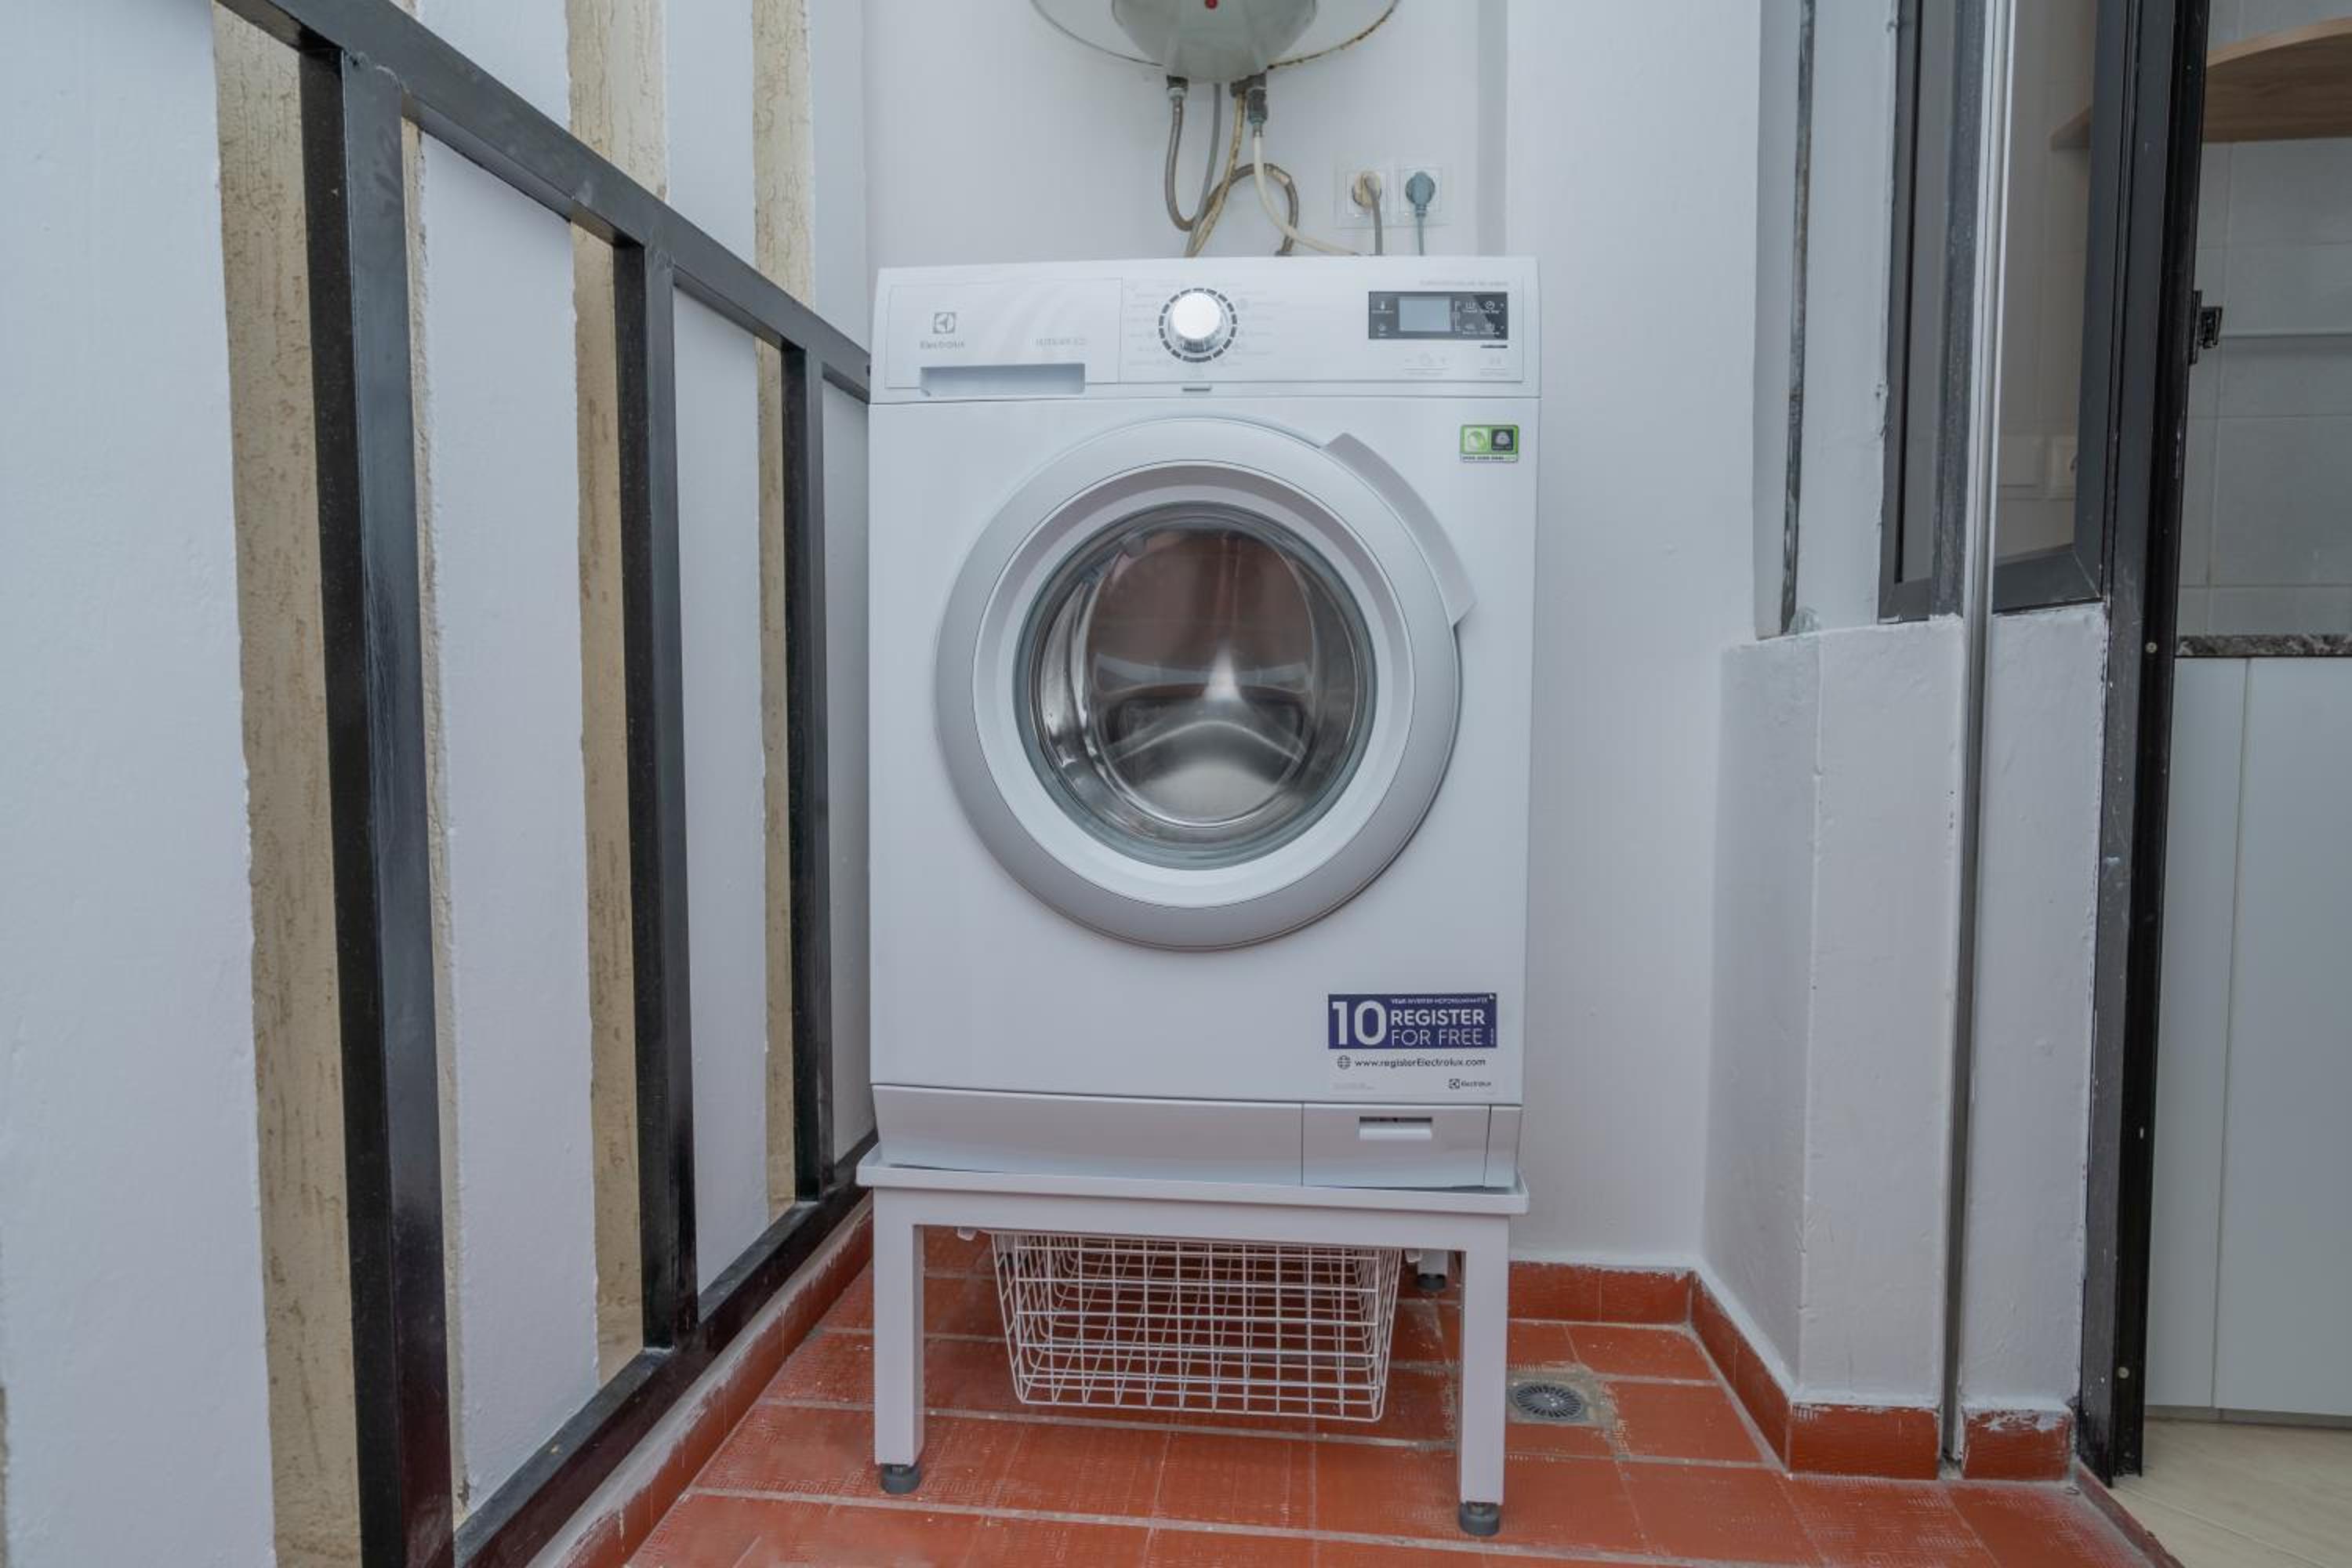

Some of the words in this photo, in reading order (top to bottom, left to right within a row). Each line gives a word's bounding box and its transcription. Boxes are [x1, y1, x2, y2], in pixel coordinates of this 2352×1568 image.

[1332, 1000, 1387, 1046] 10
[1390, 1009, 1486, 1026] REGISTER
[1392, 1029, 1432, 1046] FOR
[1439, 1029, 1483, 1045] FREE
[1354, 1057, 1486, 1069] www.registerElectrolux.com
